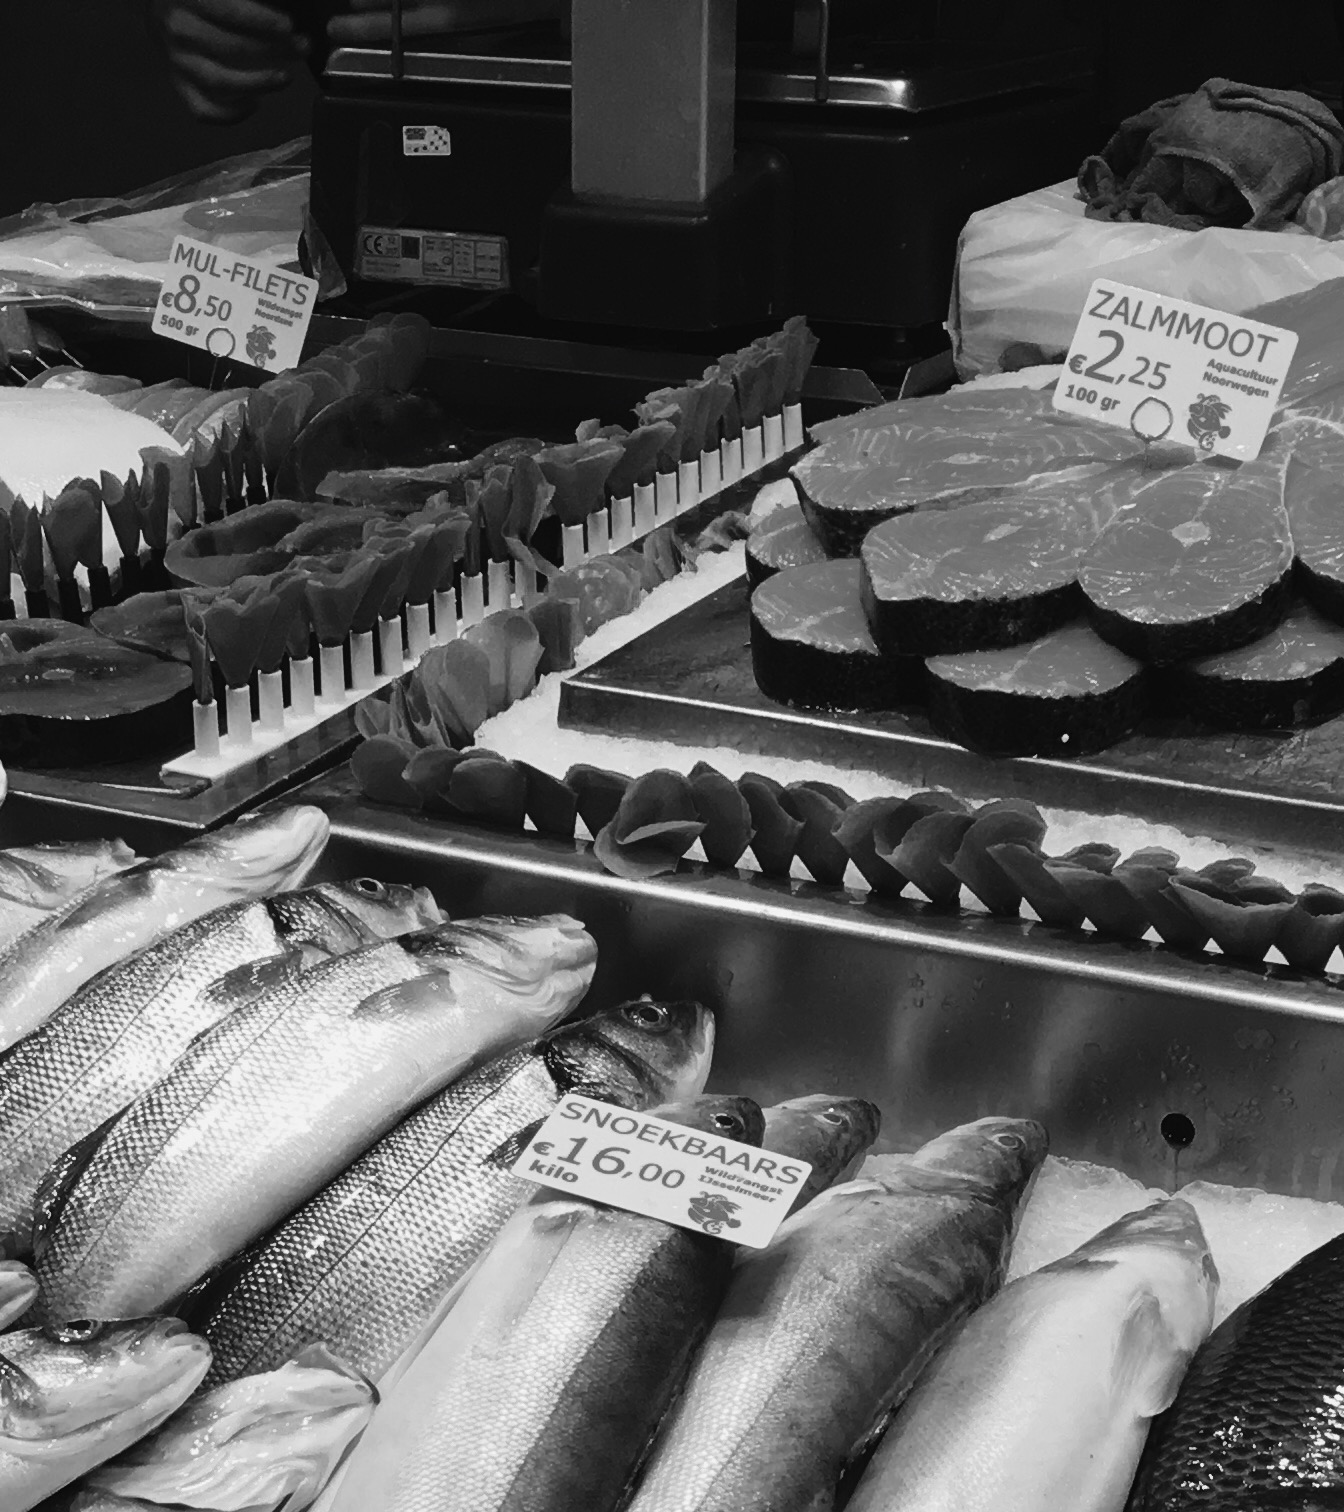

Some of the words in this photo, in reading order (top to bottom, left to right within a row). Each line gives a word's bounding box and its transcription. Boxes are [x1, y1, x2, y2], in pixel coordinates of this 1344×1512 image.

[174, 243, 309, 305] MUL-FILETS
[160, 314, 184, 330] 500
[186, 324, 200, 336] gr
[1088, 289, 1279, 363] ZALMMOOT
[1203, 371, 1270, 398] Noorwegen
[1206, 358, 1279, 386] Aquacultuur
[1064, 384, 1098, 405] 100
[1097, 395, 1121, 411] gr
[560, 1101, 803, 1185] SNOEKBAARS
[528, 1159, 579, 1184] kilo
[704, 1166, 784, 1196] Wildvangst
